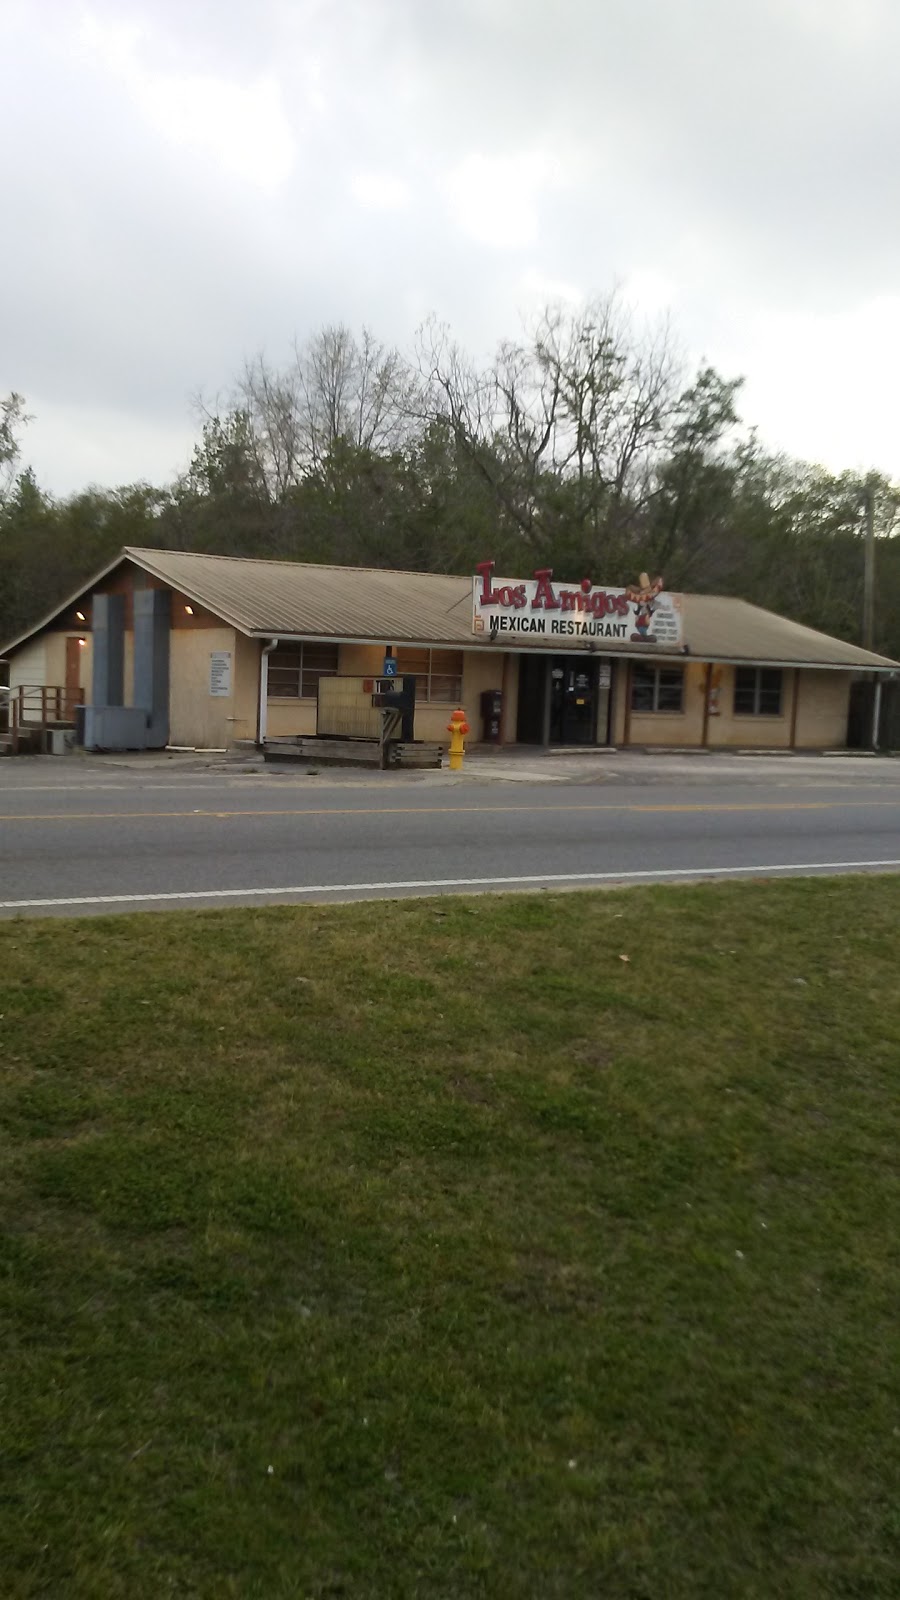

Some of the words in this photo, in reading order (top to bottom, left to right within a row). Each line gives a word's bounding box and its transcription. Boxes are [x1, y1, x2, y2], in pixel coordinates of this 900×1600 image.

[477, 560, 527, 609] Los
[532, 568, 630, 619] Amigos
[489, 615, 546, 633] MEXICAN
[551, 619, 628, 638] RESTAURANT
